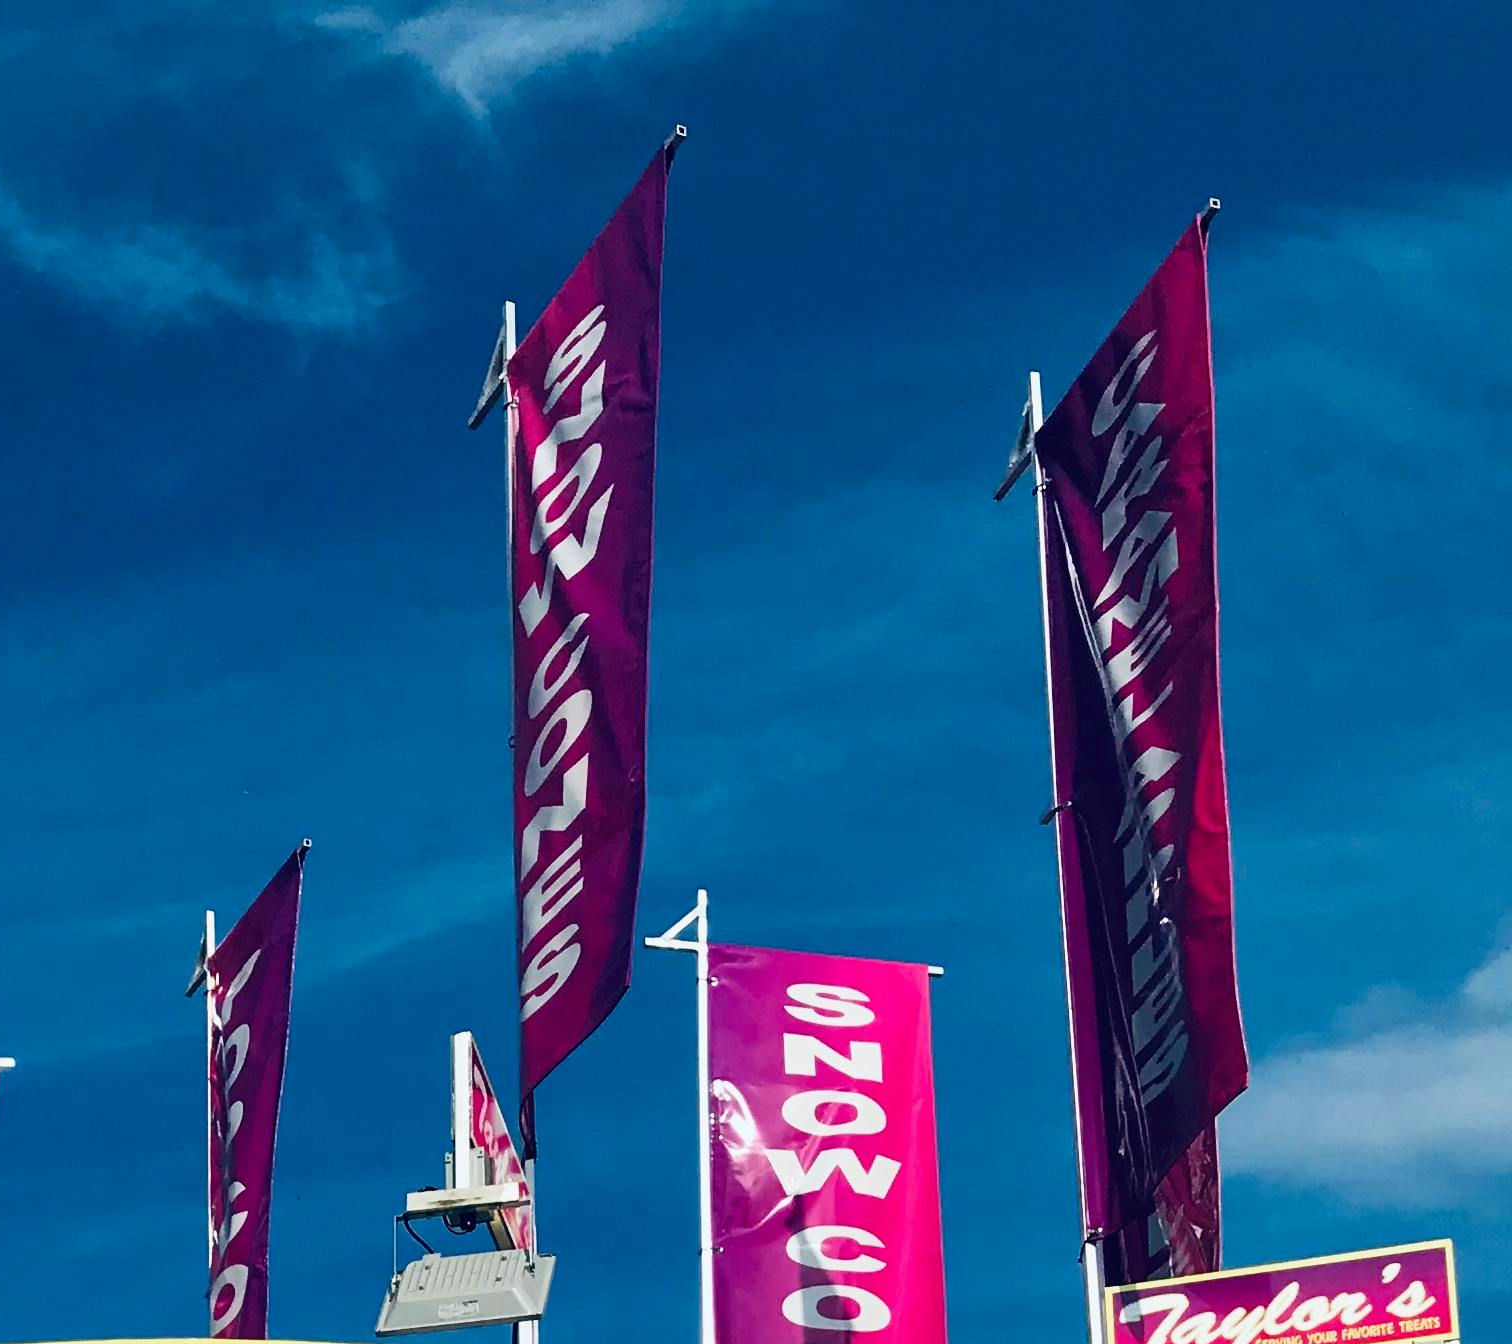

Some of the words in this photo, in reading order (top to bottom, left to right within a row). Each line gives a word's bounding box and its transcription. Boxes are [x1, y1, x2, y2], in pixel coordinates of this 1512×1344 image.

[519, 305, 614, 640] SNOW
[1091, 329, 1180, 745] CARAMEL
[521, 611, 594, 1022] CONES
[764, 983, 903, 1200] SNOW
[1341, 1321, 1394, 1341] FAVORITE
[1399, 1316, 1441, 1334] TREATS
